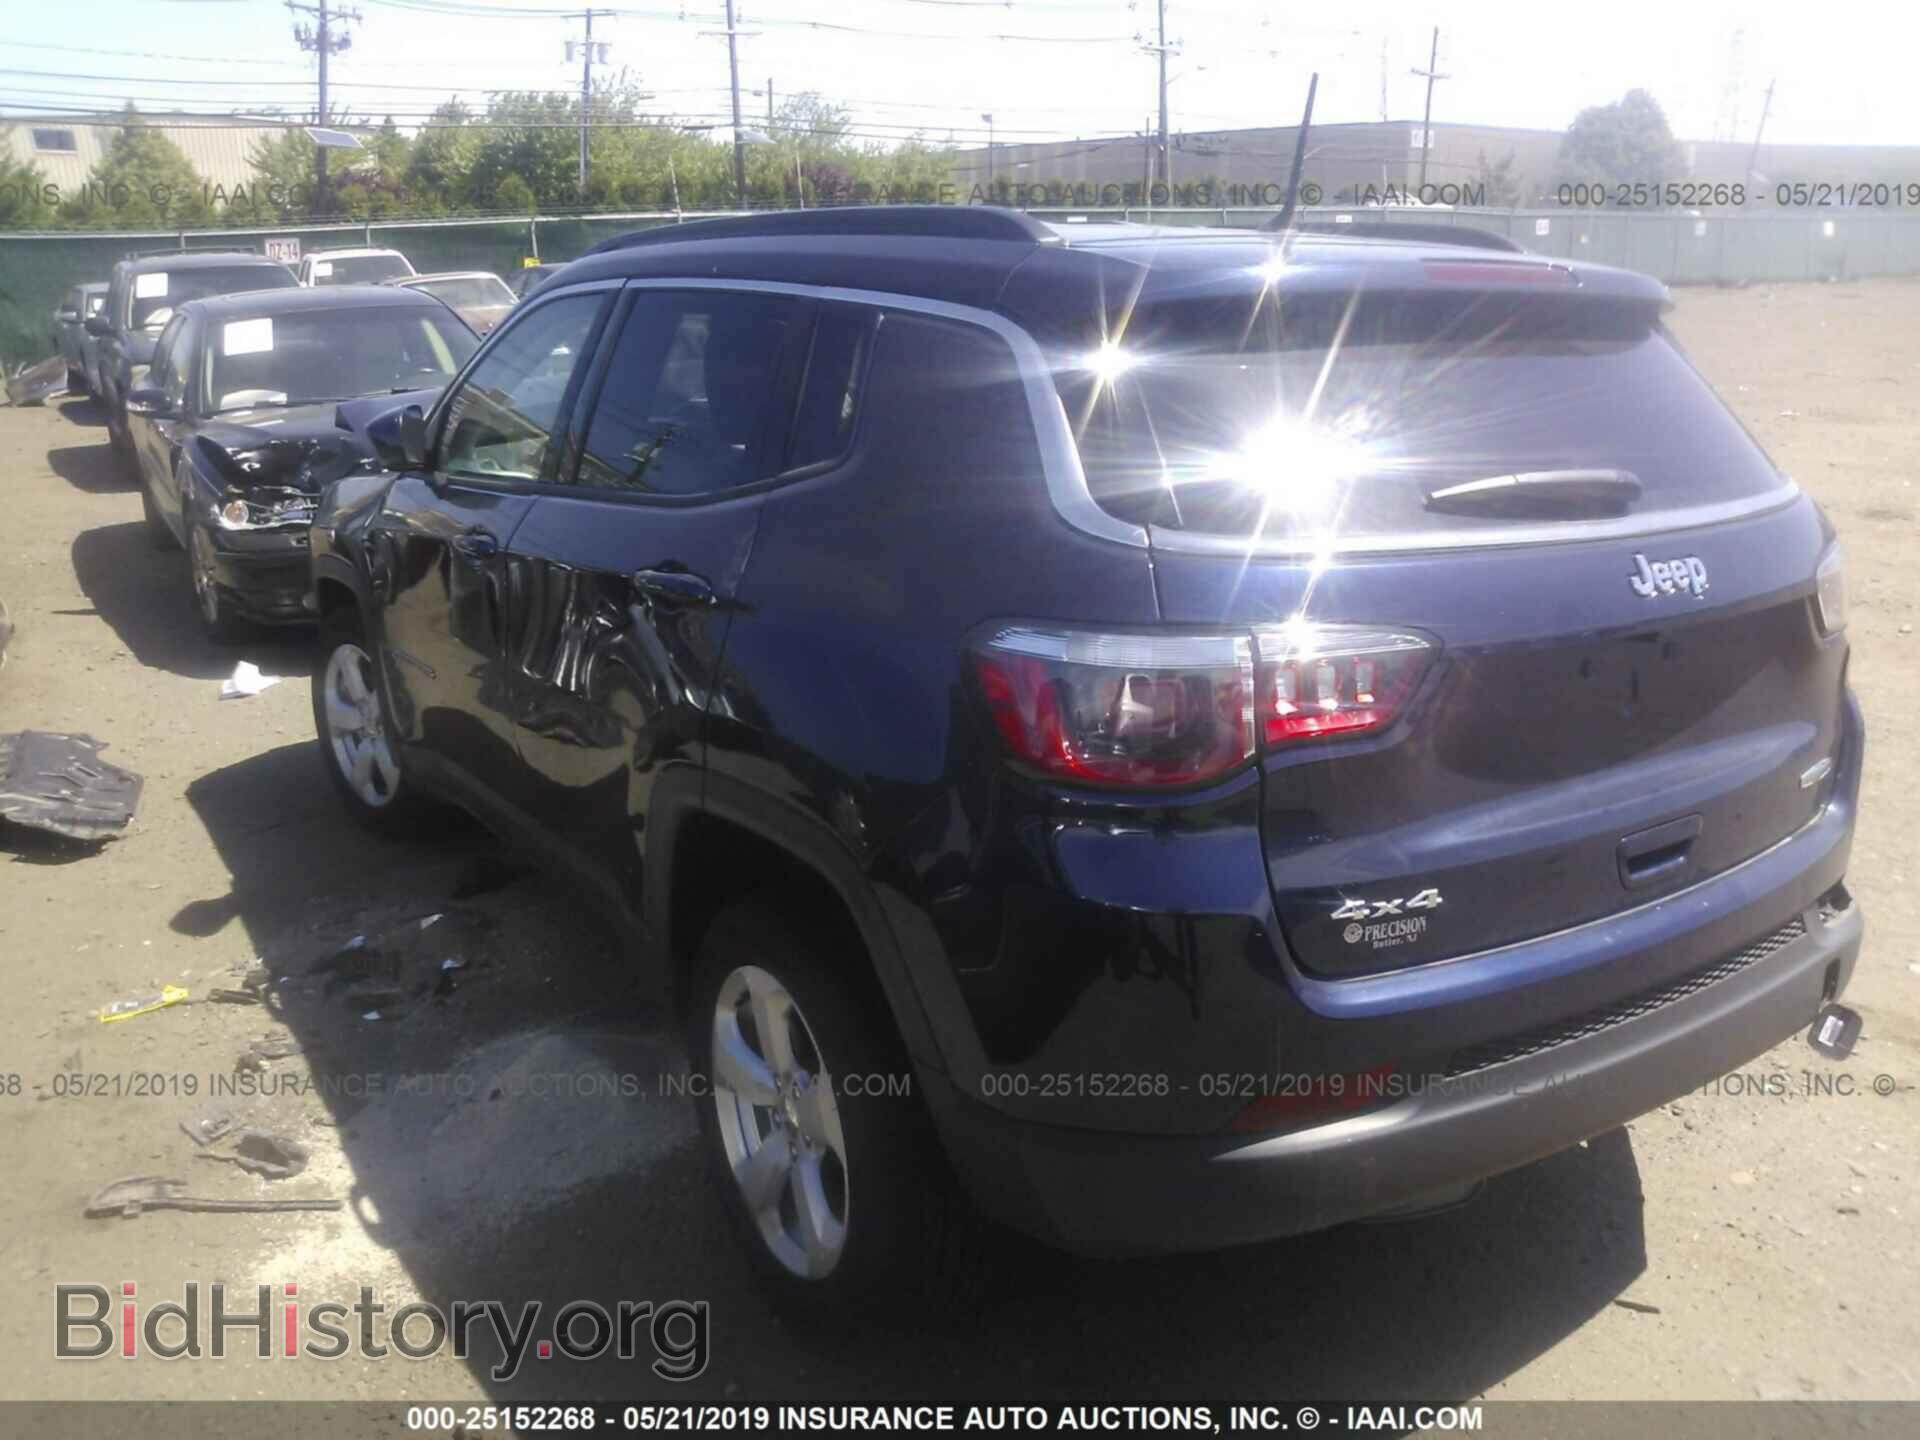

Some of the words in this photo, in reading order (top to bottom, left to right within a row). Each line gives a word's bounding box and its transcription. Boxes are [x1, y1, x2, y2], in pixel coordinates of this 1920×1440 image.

[1630, 554, 1708, 599] Jeep
[1330, 888, 1443, 919] 4x4
[1364, 917, 1427, 941] PRECISION
